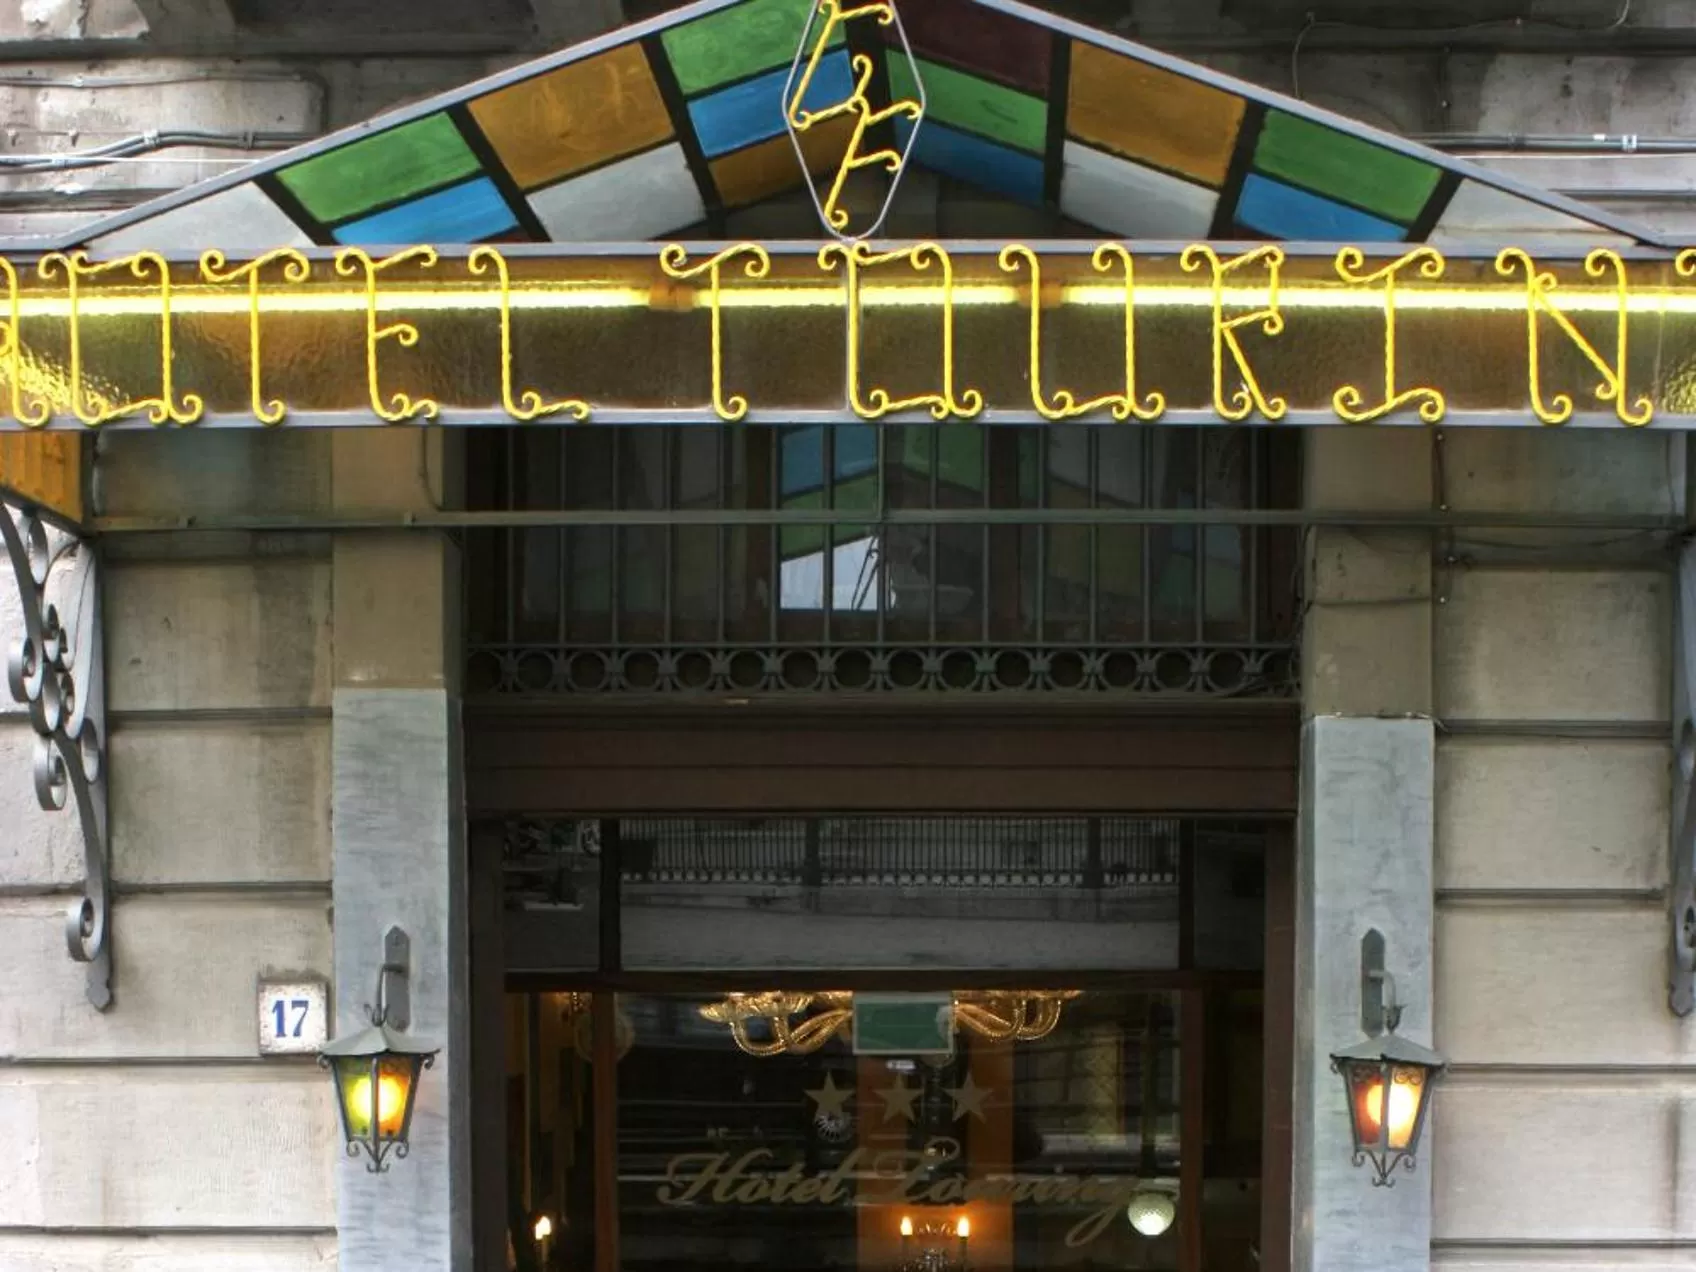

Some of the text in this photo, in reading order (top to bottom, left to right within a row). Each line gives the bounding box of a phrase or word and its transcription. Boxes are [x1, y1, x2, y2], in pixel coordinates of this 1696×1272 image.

[660, 243, 1696, 427] TOURIN
[271, 999, 309, 1038] 17
[658, 1145, 868, 1206] Hotel
